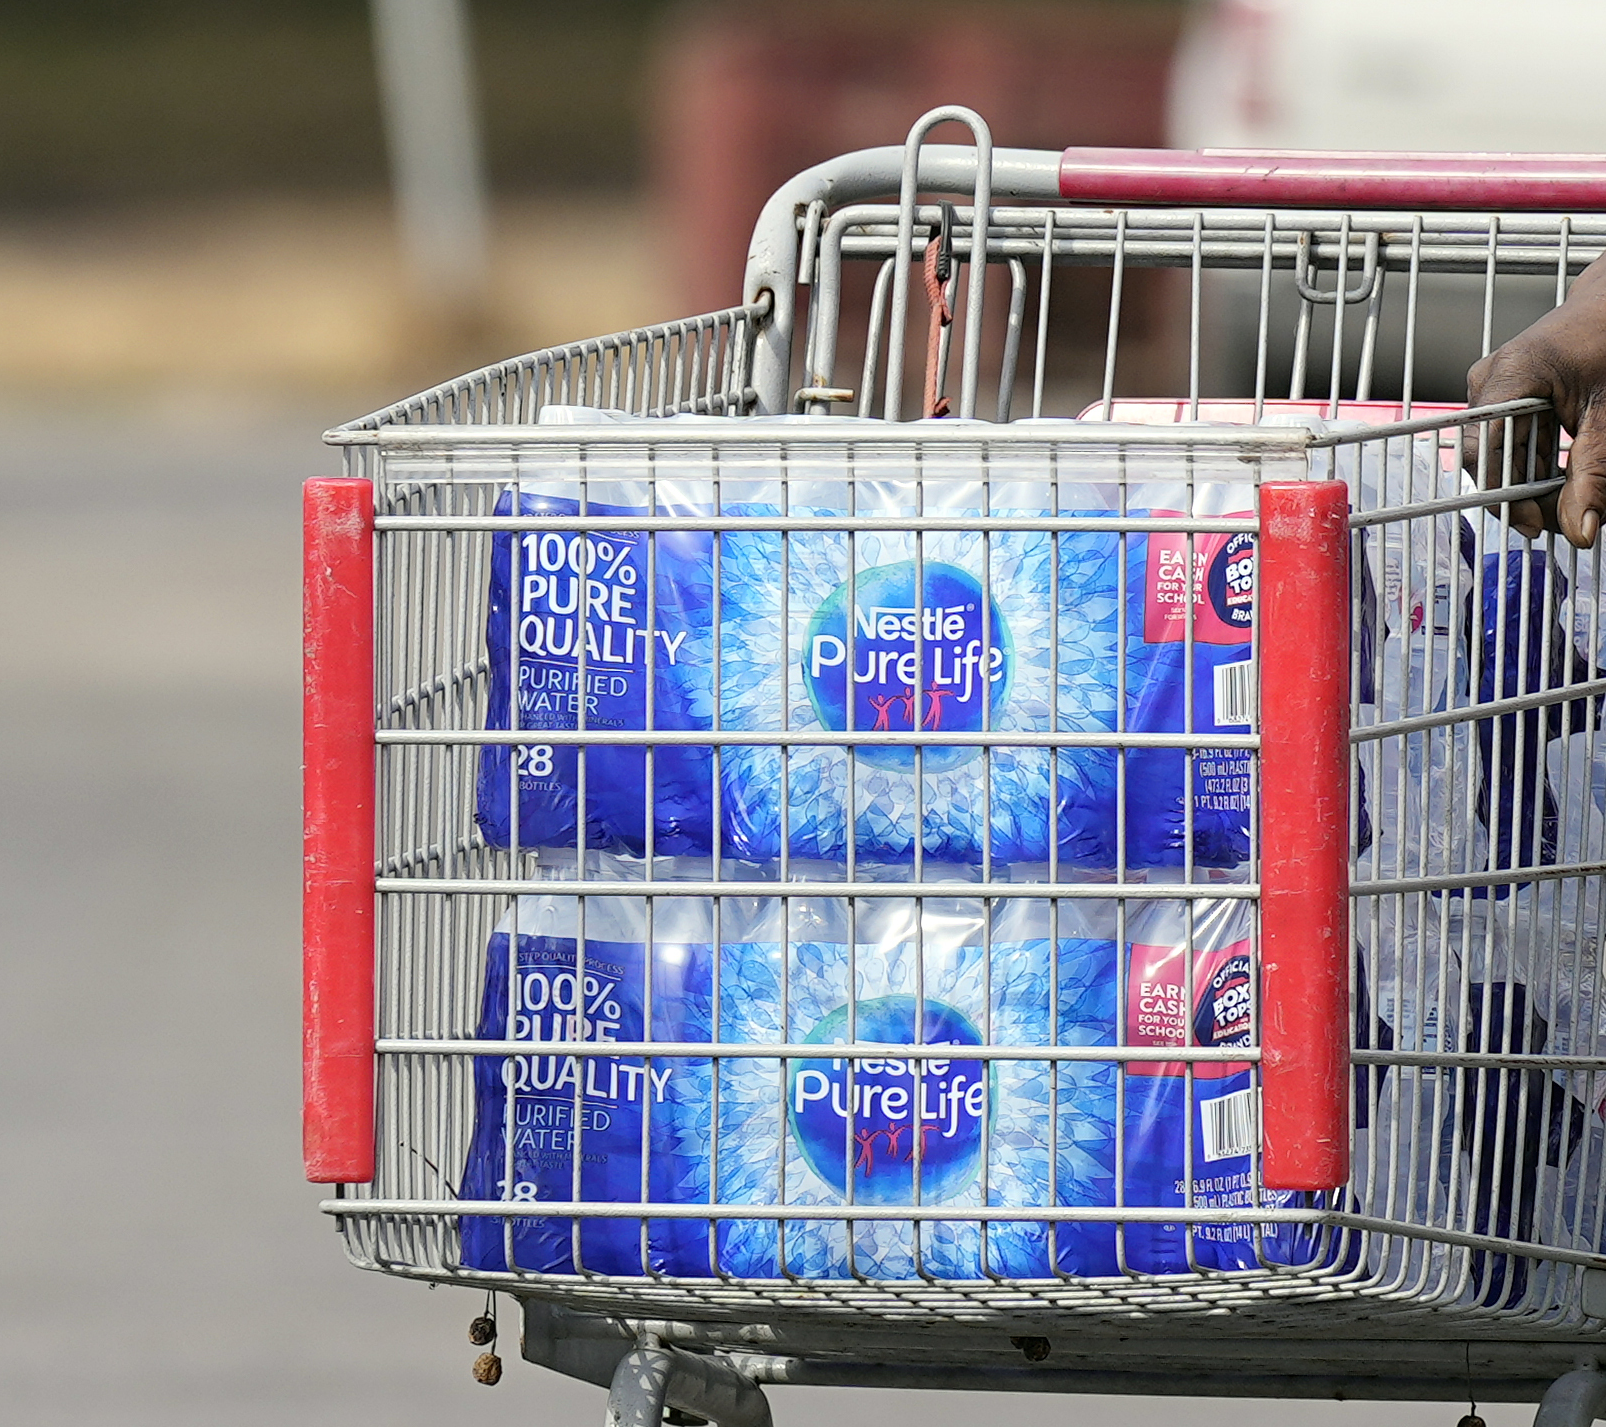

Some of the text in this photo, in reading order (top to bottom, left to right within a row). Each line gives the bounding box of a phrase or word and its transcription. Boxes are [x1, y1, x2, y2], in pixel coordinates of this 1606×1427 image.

[1226, 533, 1254, 555] OFFIC
[522, 533, 637, 586] 100%
[1159, 549, 1208, 567] EAN
[1158, 565, 1204, 582] CAH
[1225, 557, 1254, 584] BO
[1157, 581, 1202, 592] FOR YR
[1230, 575, 1253, 595] TO
[522, 575, 636, 625] PURE
[1231, 608, 1254, 622] BRA
[519, 615, 687, 666] QUALITY
[811, 635, 1003, 703] Pure Life
[1229, 760, 1251, 775] PLASTI
[541, 952, 577, 964] QUALIT
[1212, 960, 1251, 989] OFFICIA
[1138, 1014, 1185, 1027] FOR YOU
[1138, 1025, 1185, 1038] SCHOO
[501, 1054, 673, 1103] QUALITY
[795, 1070, 984, 1138] Pure Life
